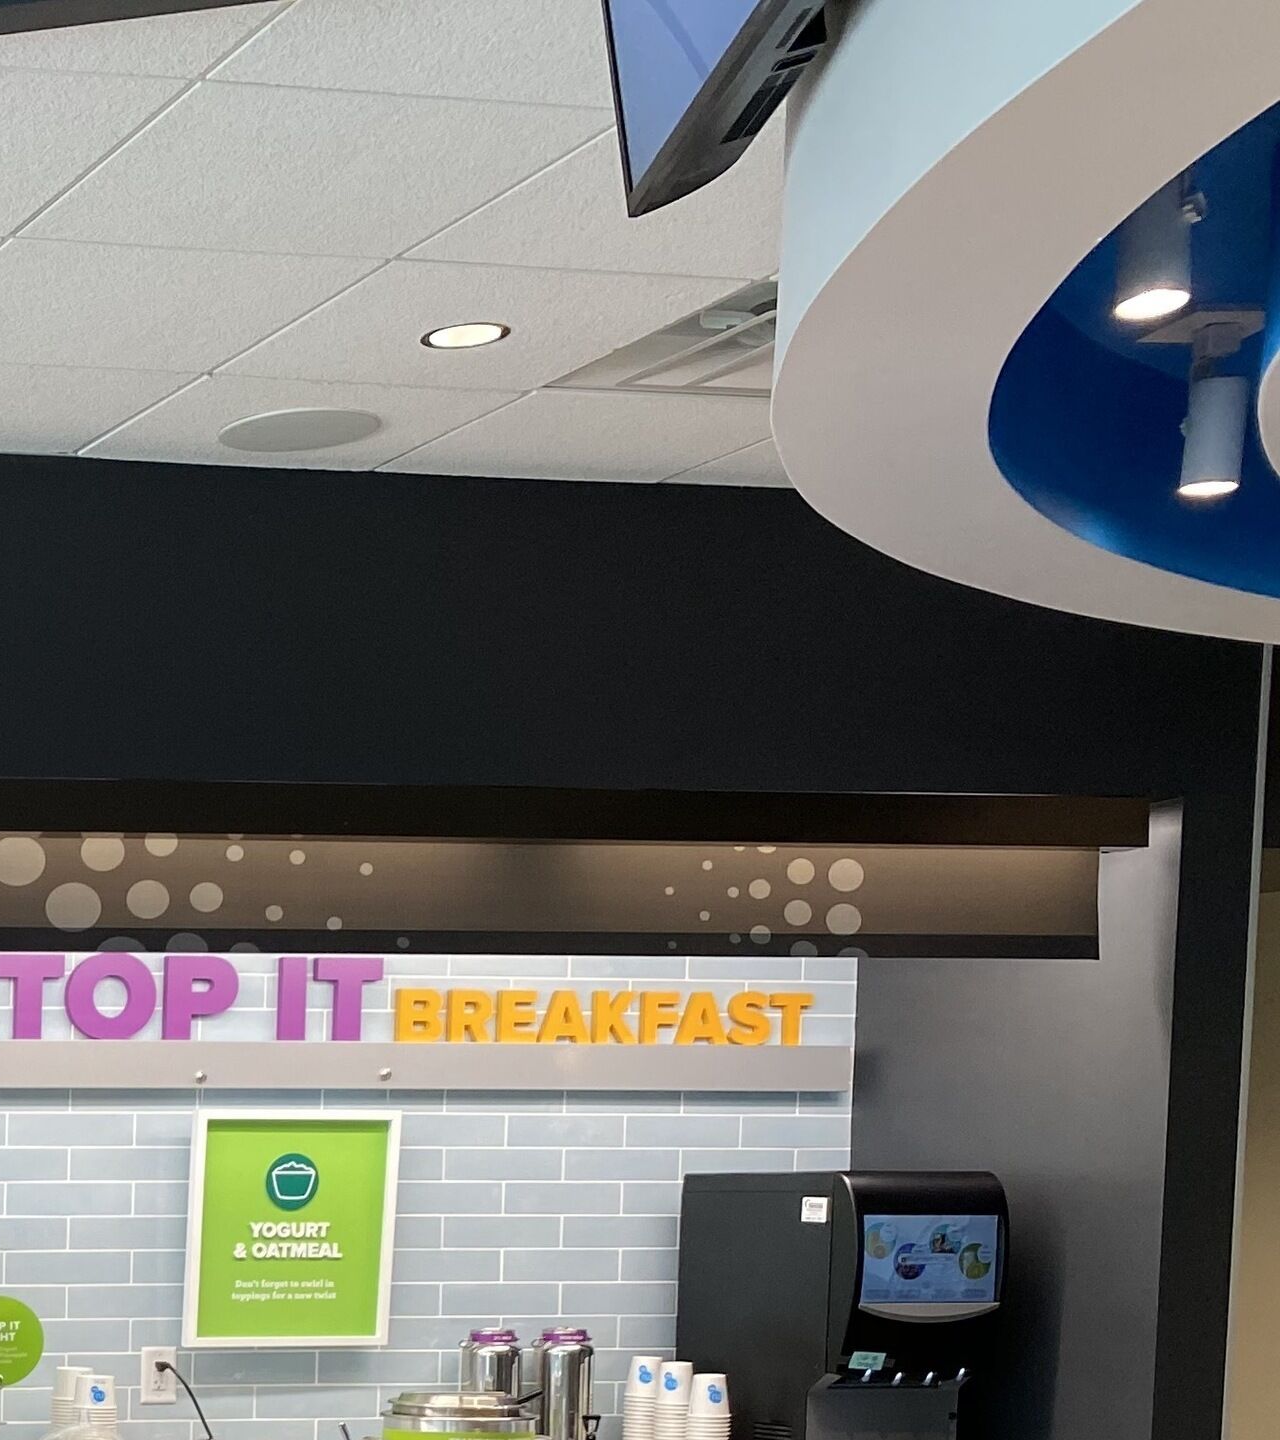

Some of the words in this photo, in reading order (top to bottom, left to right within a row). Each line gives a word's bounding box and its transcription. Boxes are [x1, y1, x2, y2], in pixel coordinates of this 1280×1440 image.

[276, 956, 384, 1041] IT
[394, 988, 815, 1046] BREAKFAST
[249, 1221, 330, 1238] YOGURT
[233, 1242, 247, 1258] &
[252, 1242, 343, 1258] OATMEAL
[261, 1279, 288, 1289] forget
[9, 1320, 21, 1330] IT
